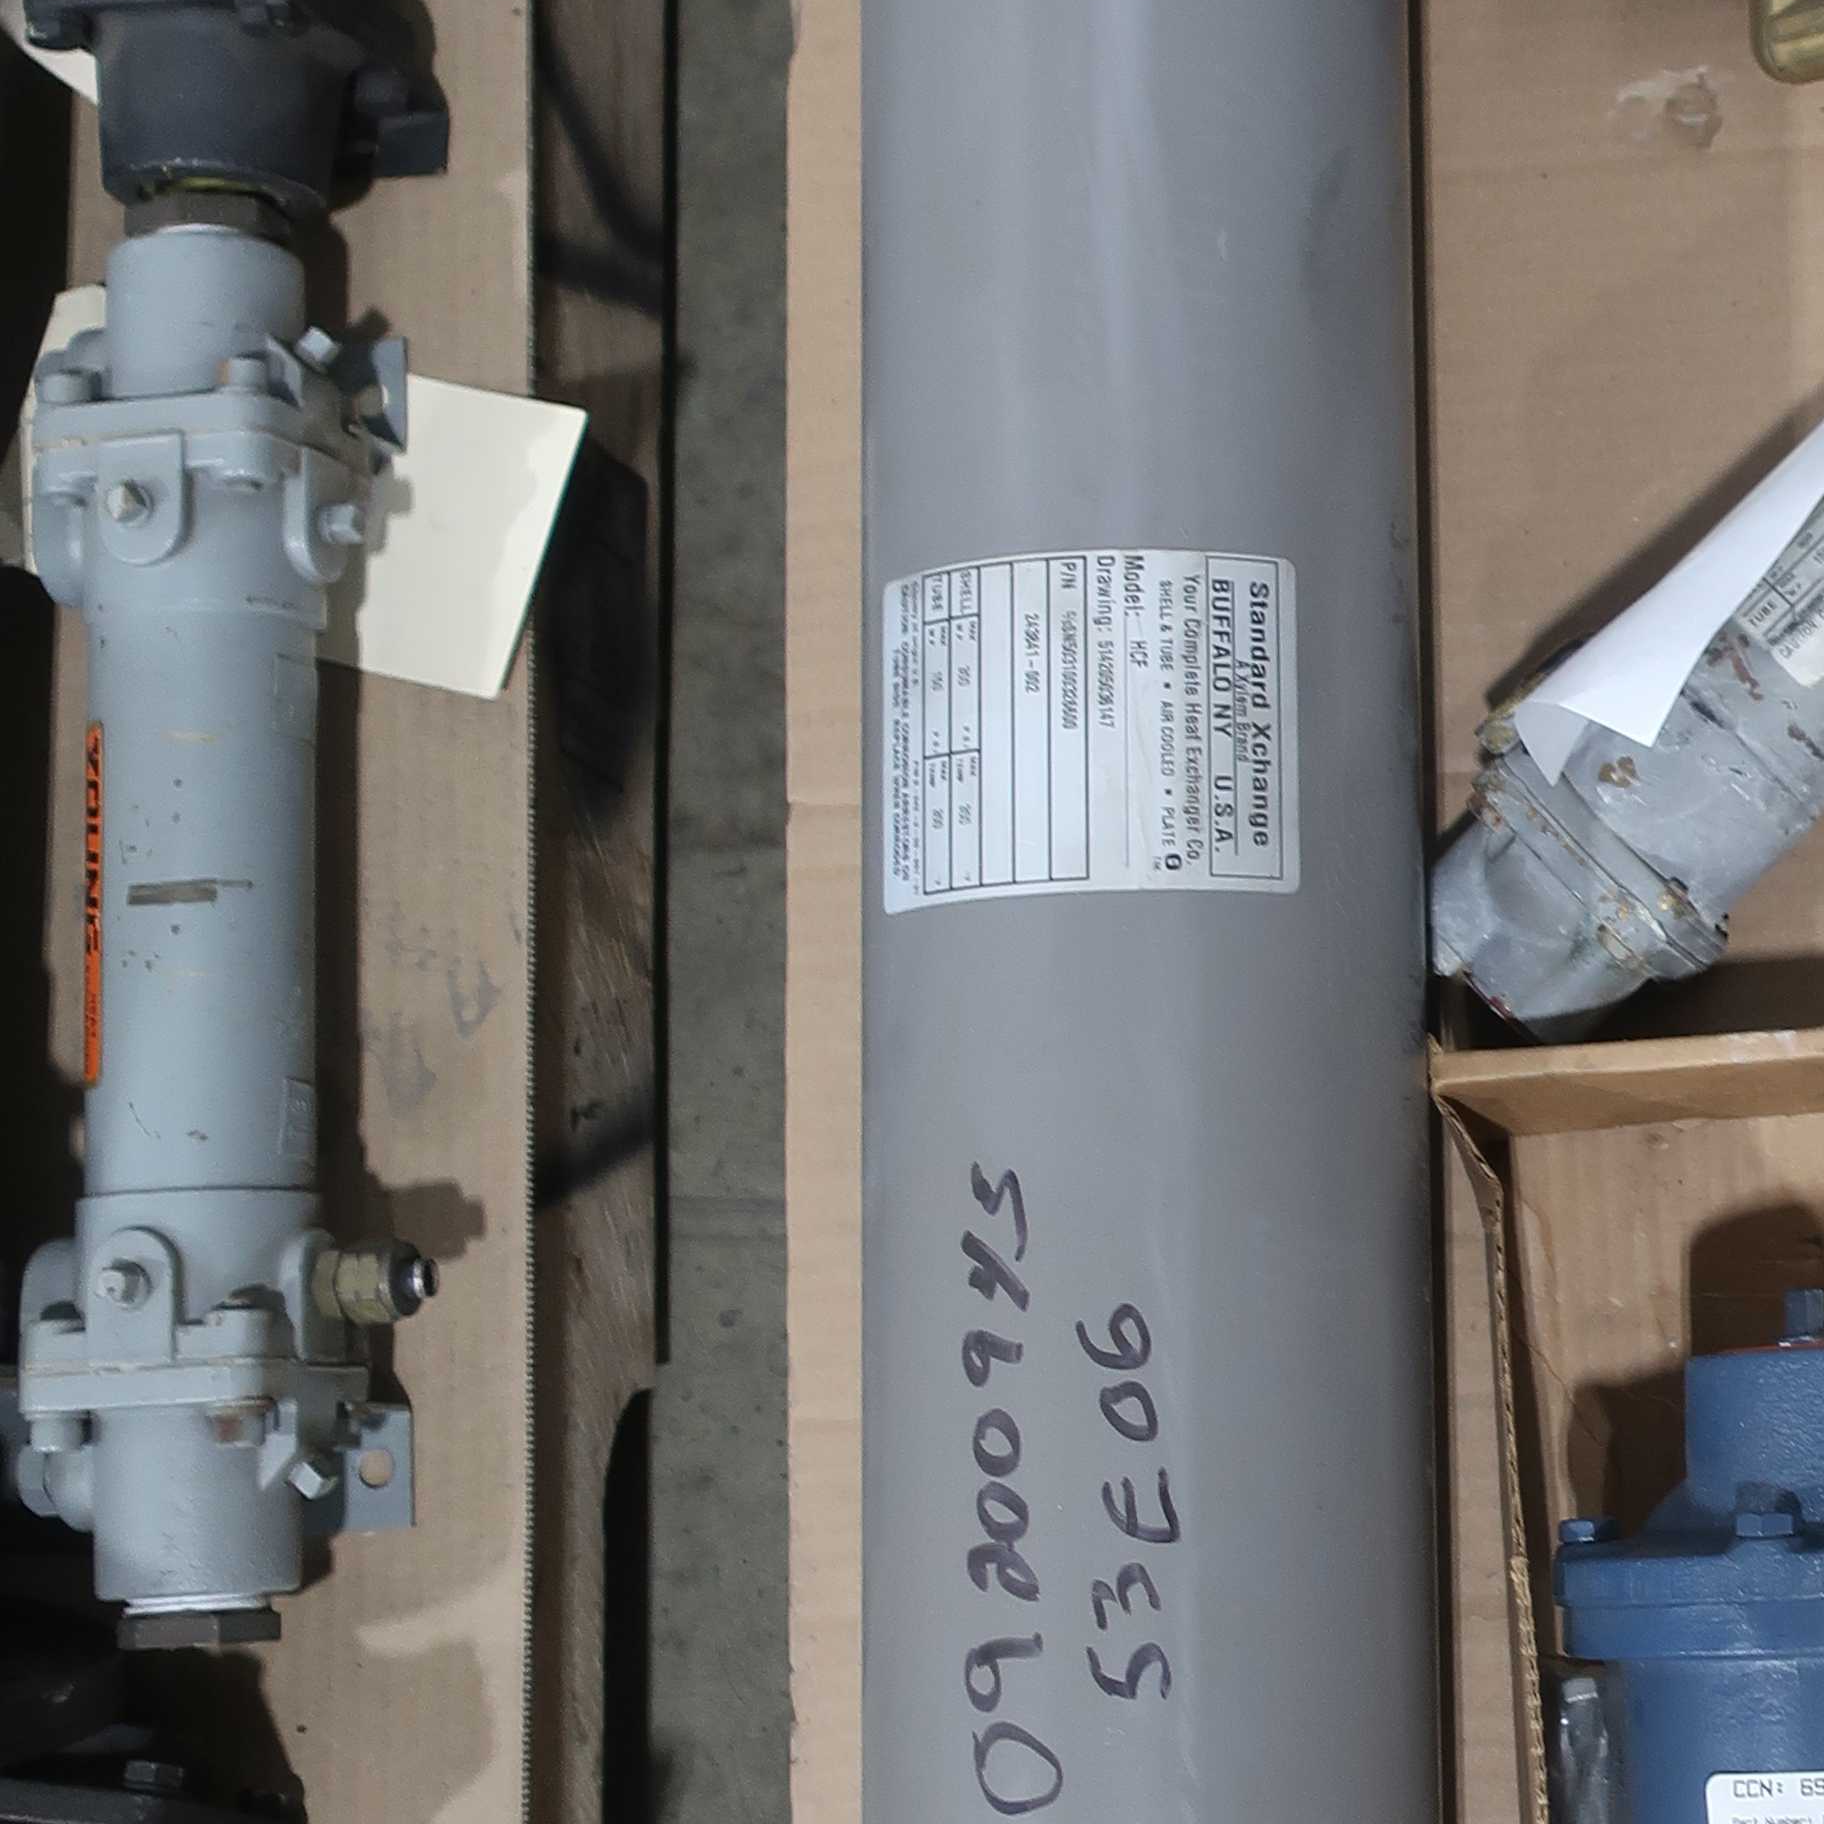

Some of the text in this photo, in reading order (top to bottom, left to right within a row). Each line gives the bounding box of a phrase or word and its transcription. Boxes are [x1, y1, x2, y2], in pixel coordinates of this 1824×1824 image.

[1061, 562, 1077, 588] P/N
[1093, 555, 1116, 632] Drawing:
[1183, 574, 1200, 613] Your
[1124, 555, 1148, 668] Model: HCF
[1159, 580, 1172, 622] SHELL
[1160, 638, 1173, 671] TUBE
[1182, 618, 1201, 696] Complete
[1161, 700, 1173, 723] AIR
[1211, 578, 1233, 853] BUFFALO NY U.S.A.
[1234, 674, 1250, 718] Xylem
[1249, 582, 1272, 848] Standard Xchange
[1185, 703, 1201, 741] Heat
[1236, 722, 1251, 763] Brand
[1161, 726, 1174, 777] COOLED
[1183, 747, 1203, 833] Exchanger
[1161, 806, 1175, 847] PLATE
[1733, 1781, 1785, 1798] CCN:
